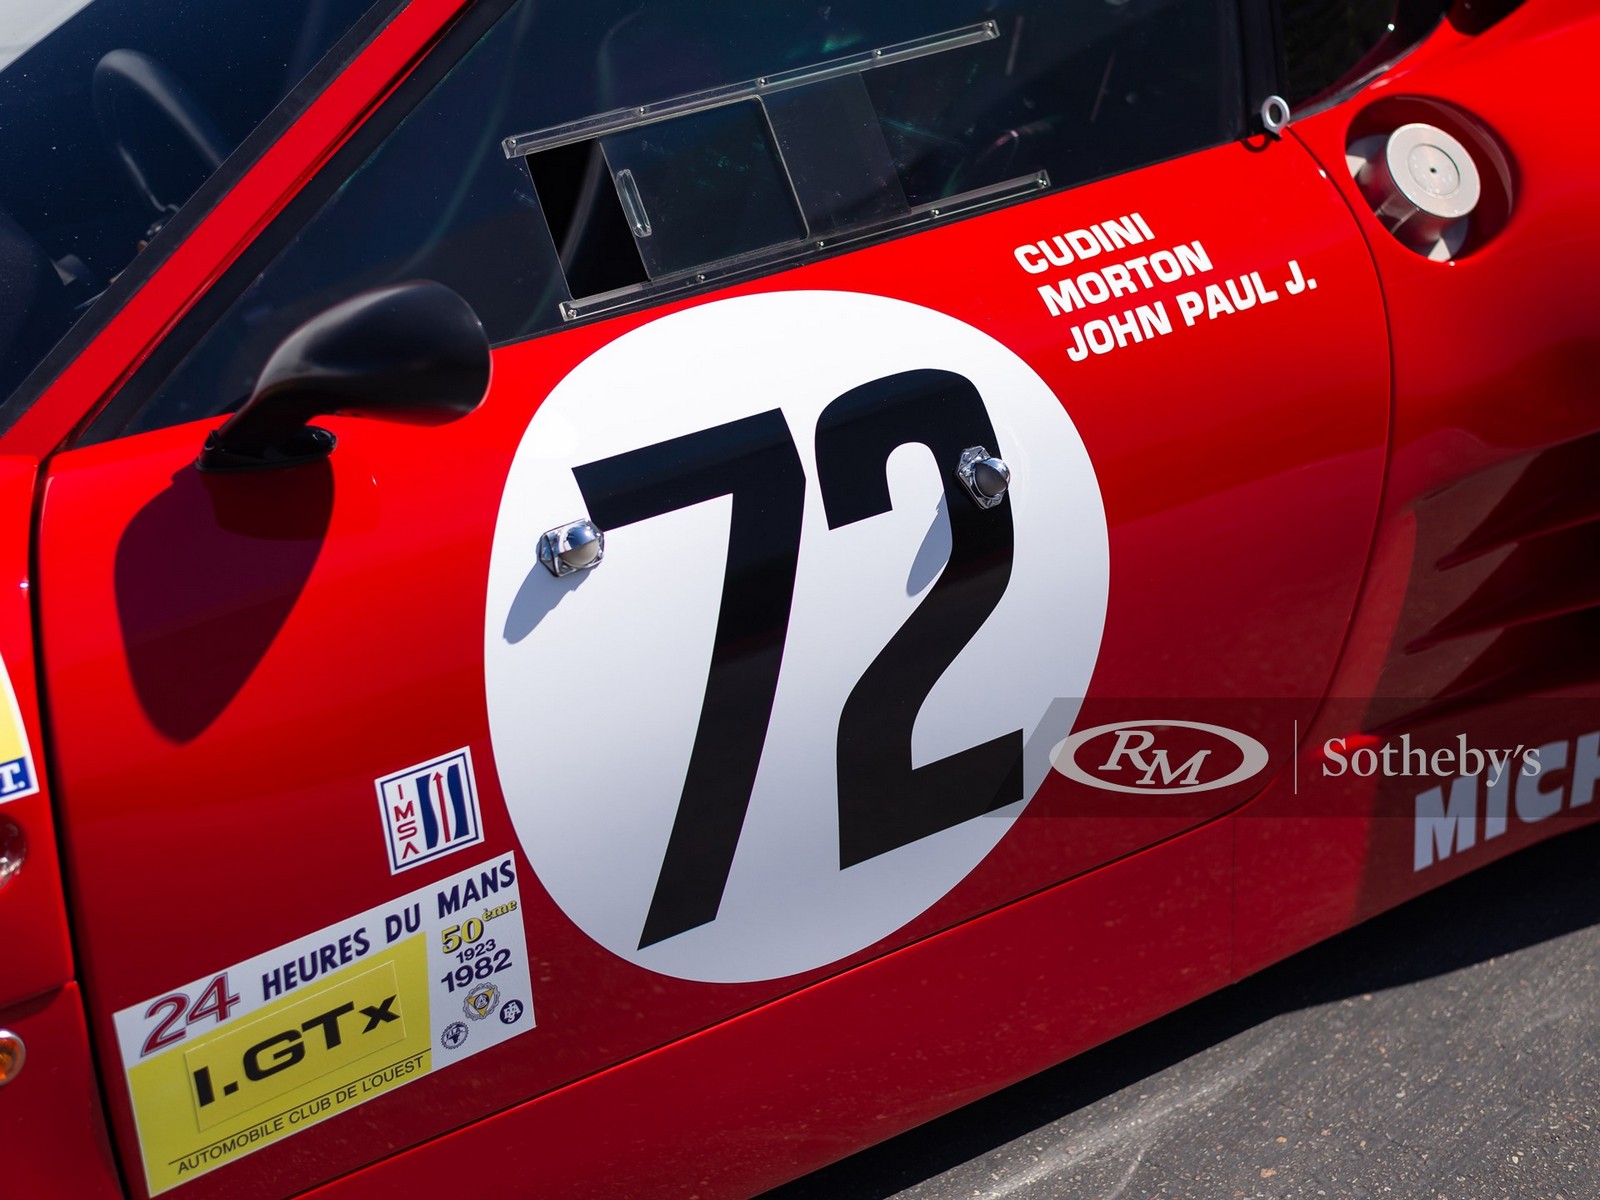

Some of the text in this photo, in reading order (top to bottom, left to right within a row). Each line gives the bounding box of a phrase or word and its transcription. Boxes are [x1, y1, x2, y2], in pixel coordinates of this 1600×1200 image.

[1013, 212, 1155, 274] CUDINI
[1037, 240, 1214, 317] MORTON
[1066, 259, 1318, 362] JOHN PAUL J.
[571, 368, 1024, 951] 72
[394, 784, 420, 860] IMSA
[140, 859, 515, 1059] 24 HEURES DU MANS
[441, 948, 513, 993] 1982
[456, 938, 497, 964] 1923
[178, 1056, 424, 1175] AUTOMOBILE CLUB DE L'OUEST
